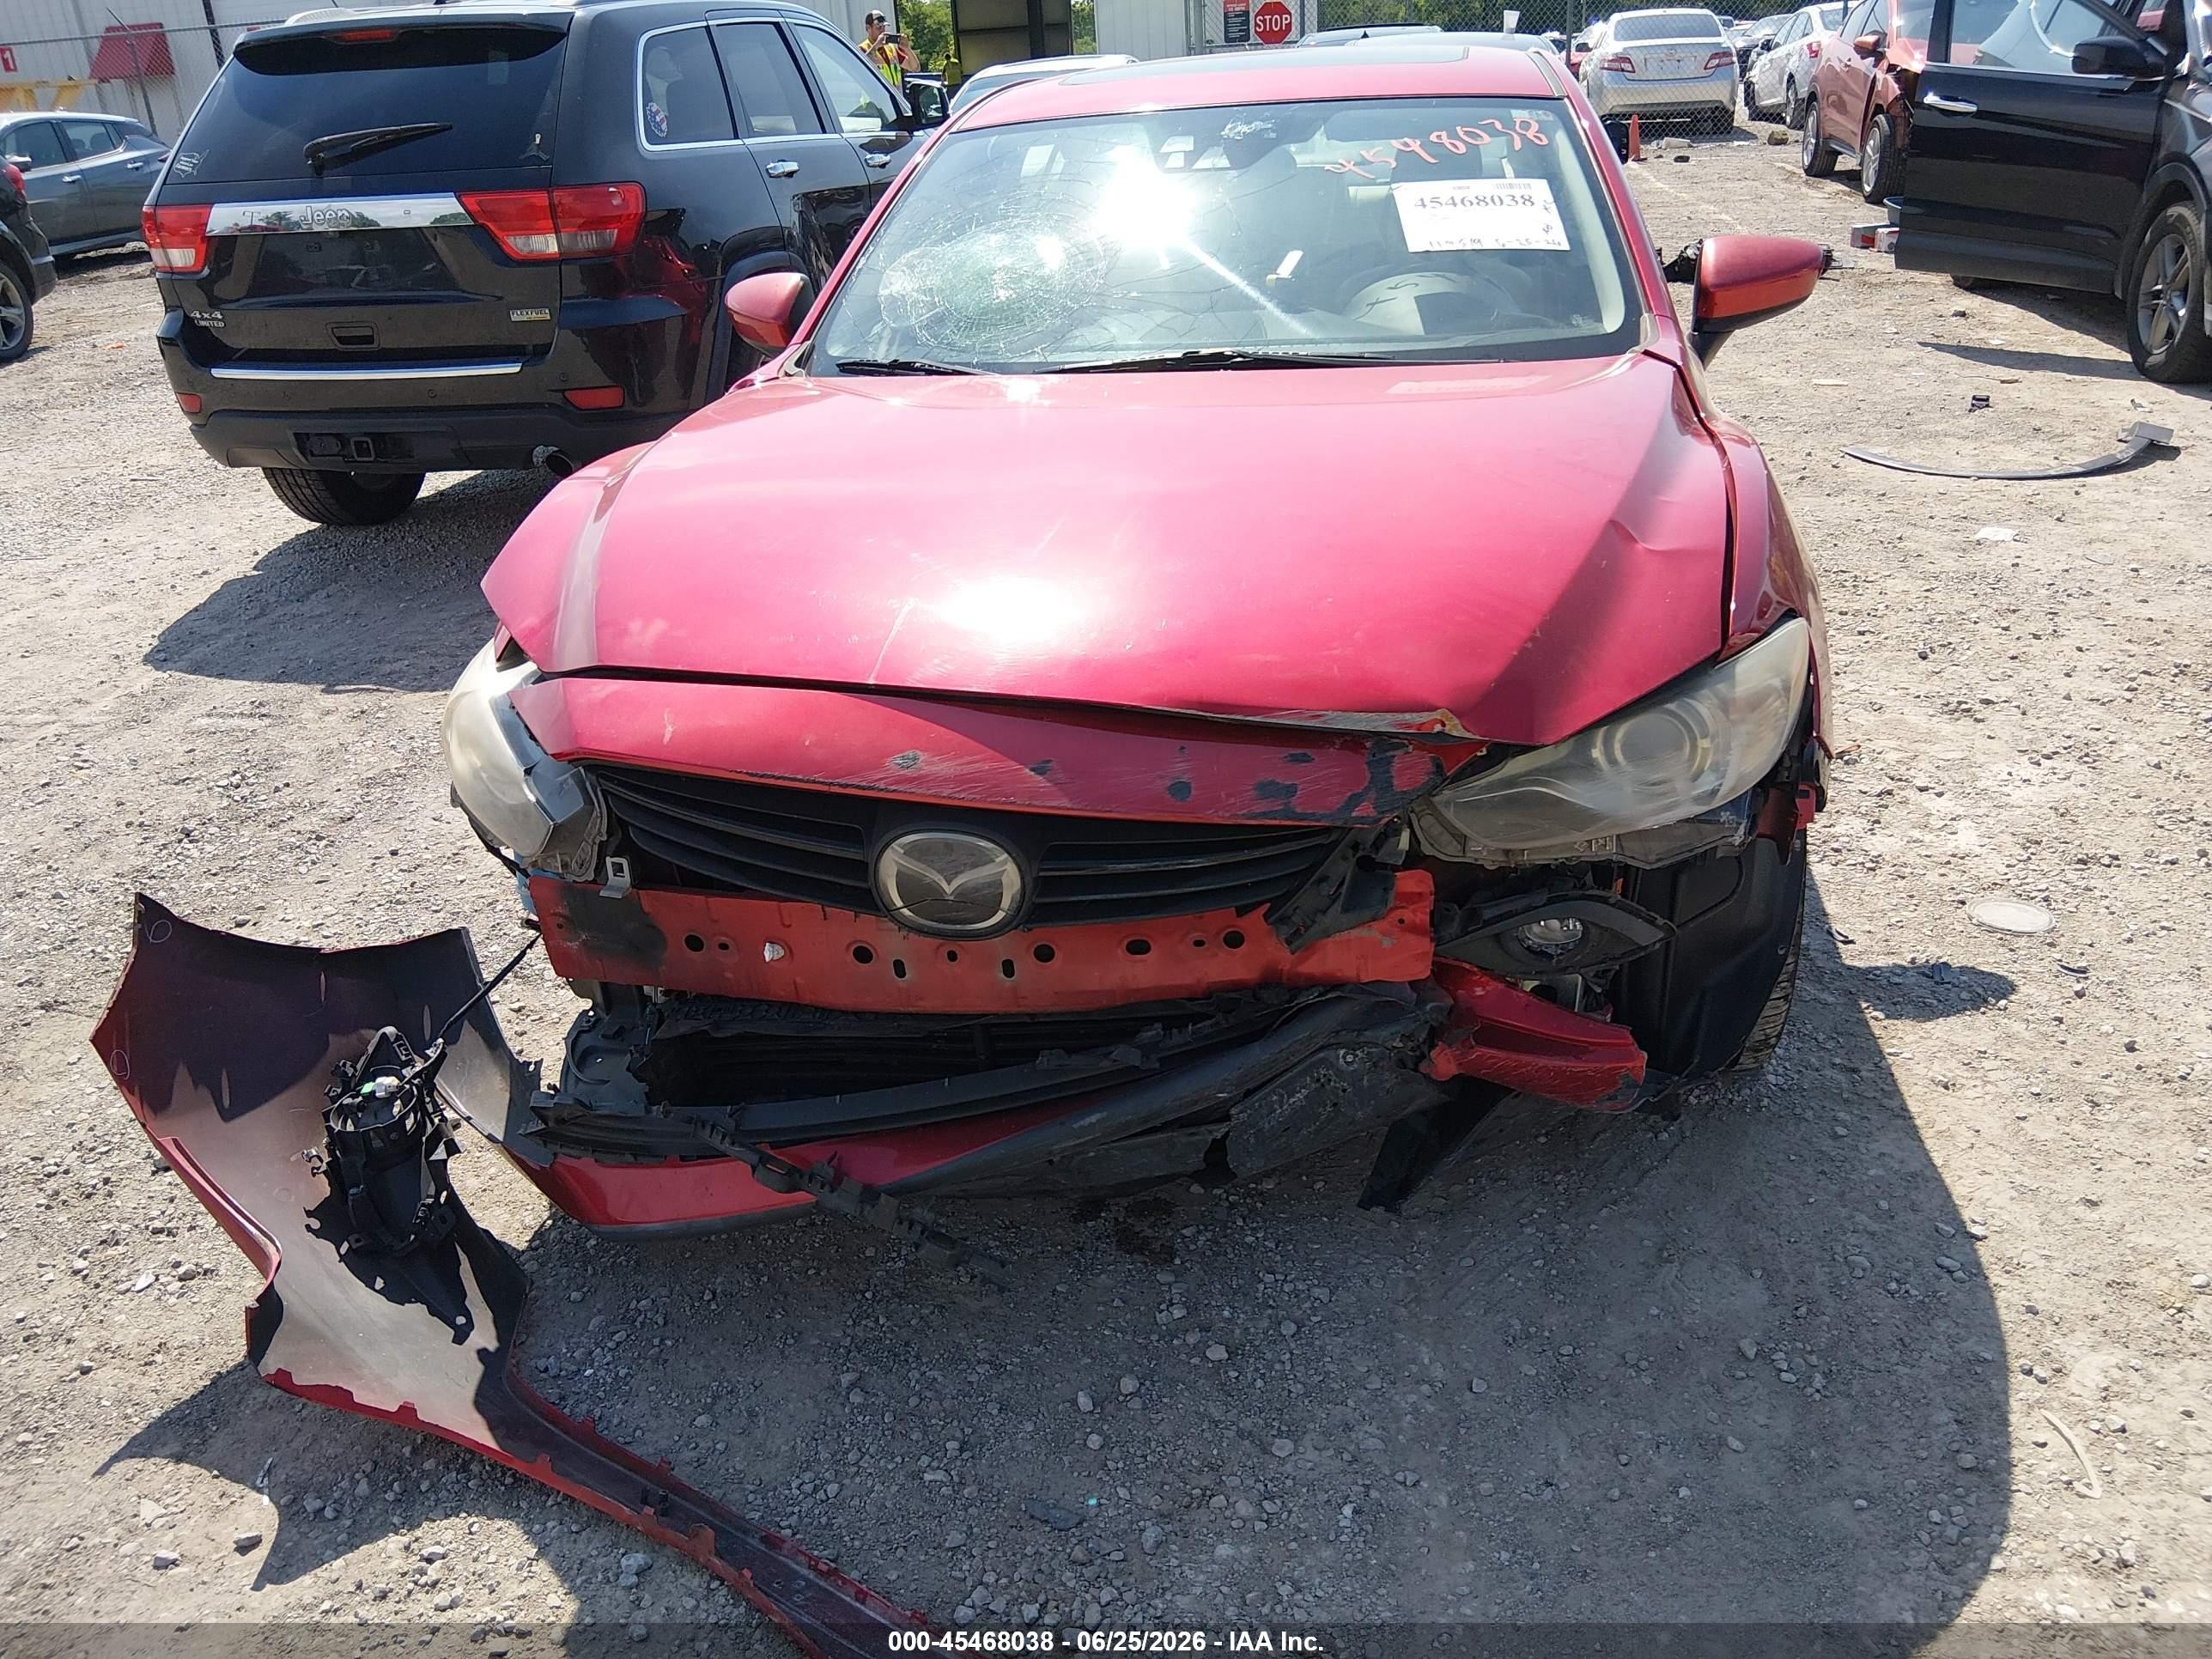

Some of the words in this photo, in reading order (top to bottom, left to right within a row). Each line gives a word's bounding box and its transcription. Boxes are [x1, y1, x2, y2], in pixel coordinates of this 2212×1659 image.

[1255, 15, 1291, 32] STOP
[1414, 194, 1535, 210] 45468038
[299, 205, 351, 228] Jeep
[191, 310, 223, 319] 4x4
